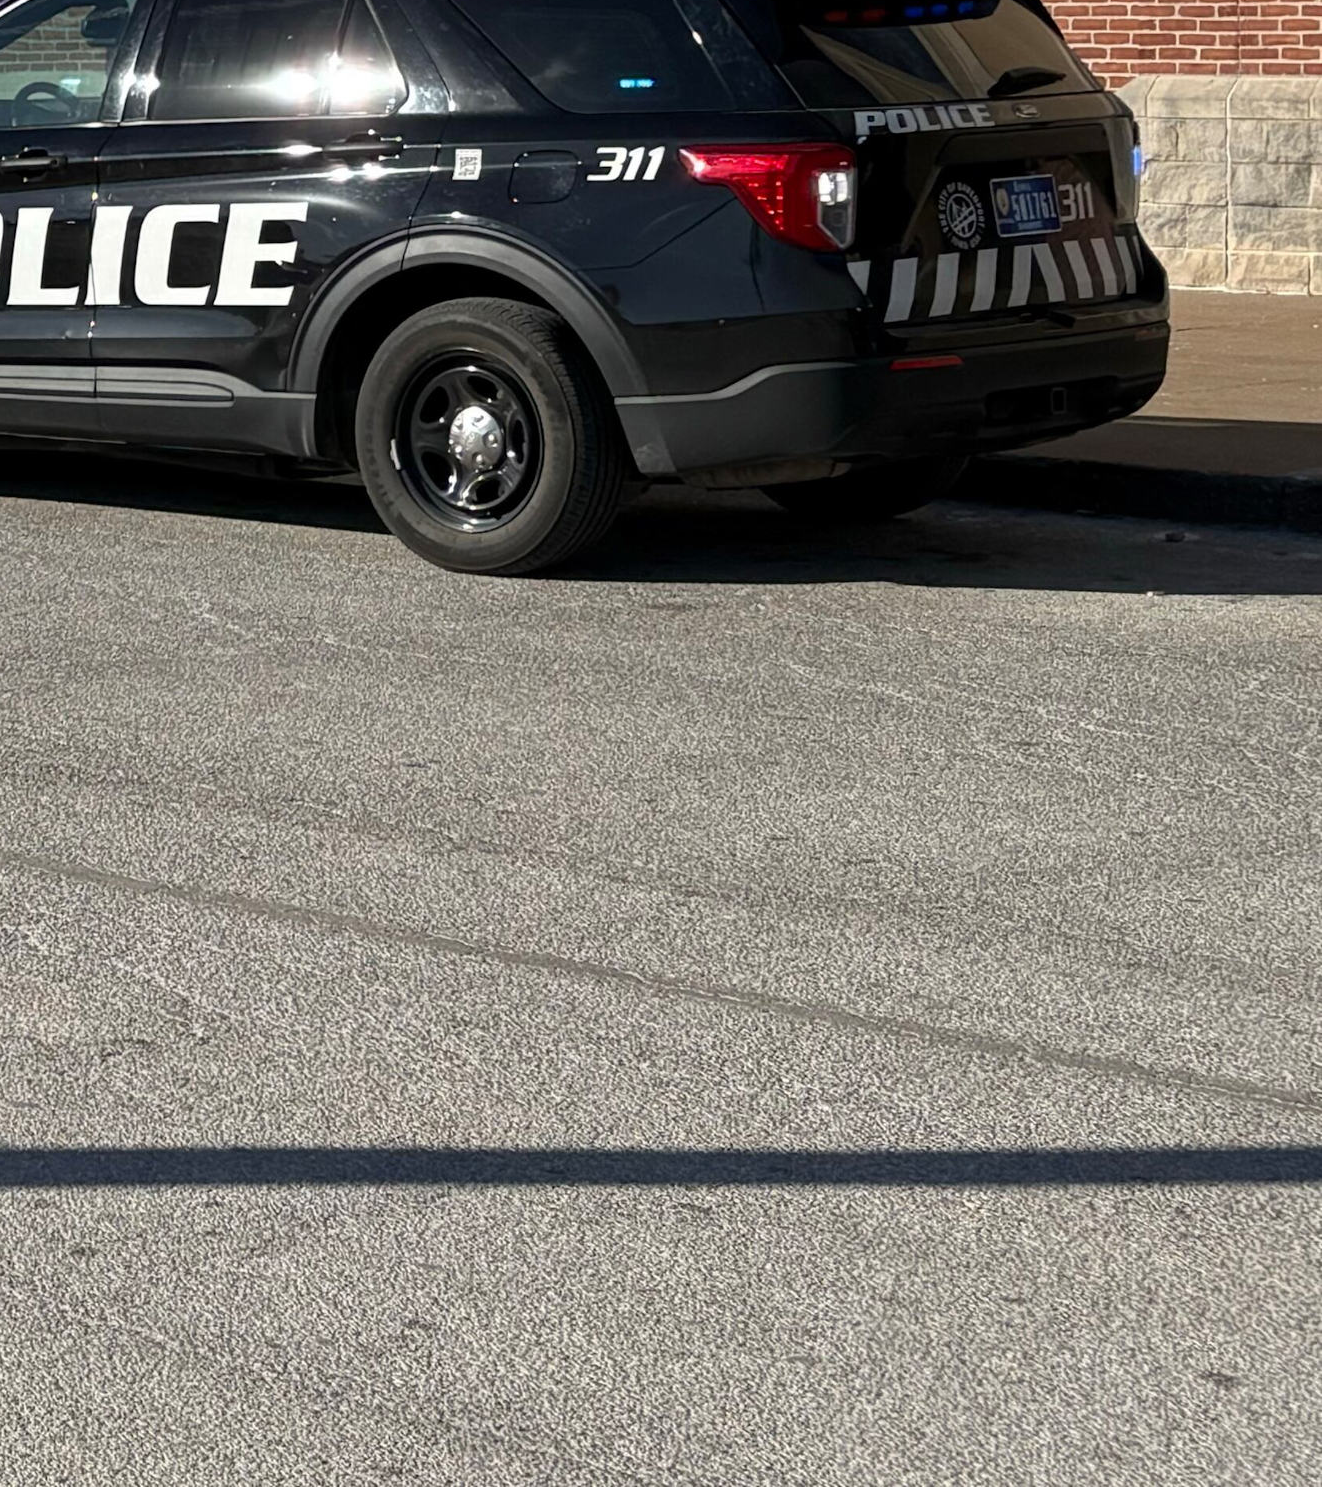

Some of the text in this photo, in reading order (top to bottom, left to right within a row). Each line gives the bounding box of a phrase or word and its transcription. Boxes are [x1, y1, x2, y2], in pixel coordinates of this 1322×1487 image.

[854, 104, 995, 135] POLICE
[586, 146, 665, 182] 311
[1058, 182, 1095, 221] 311
